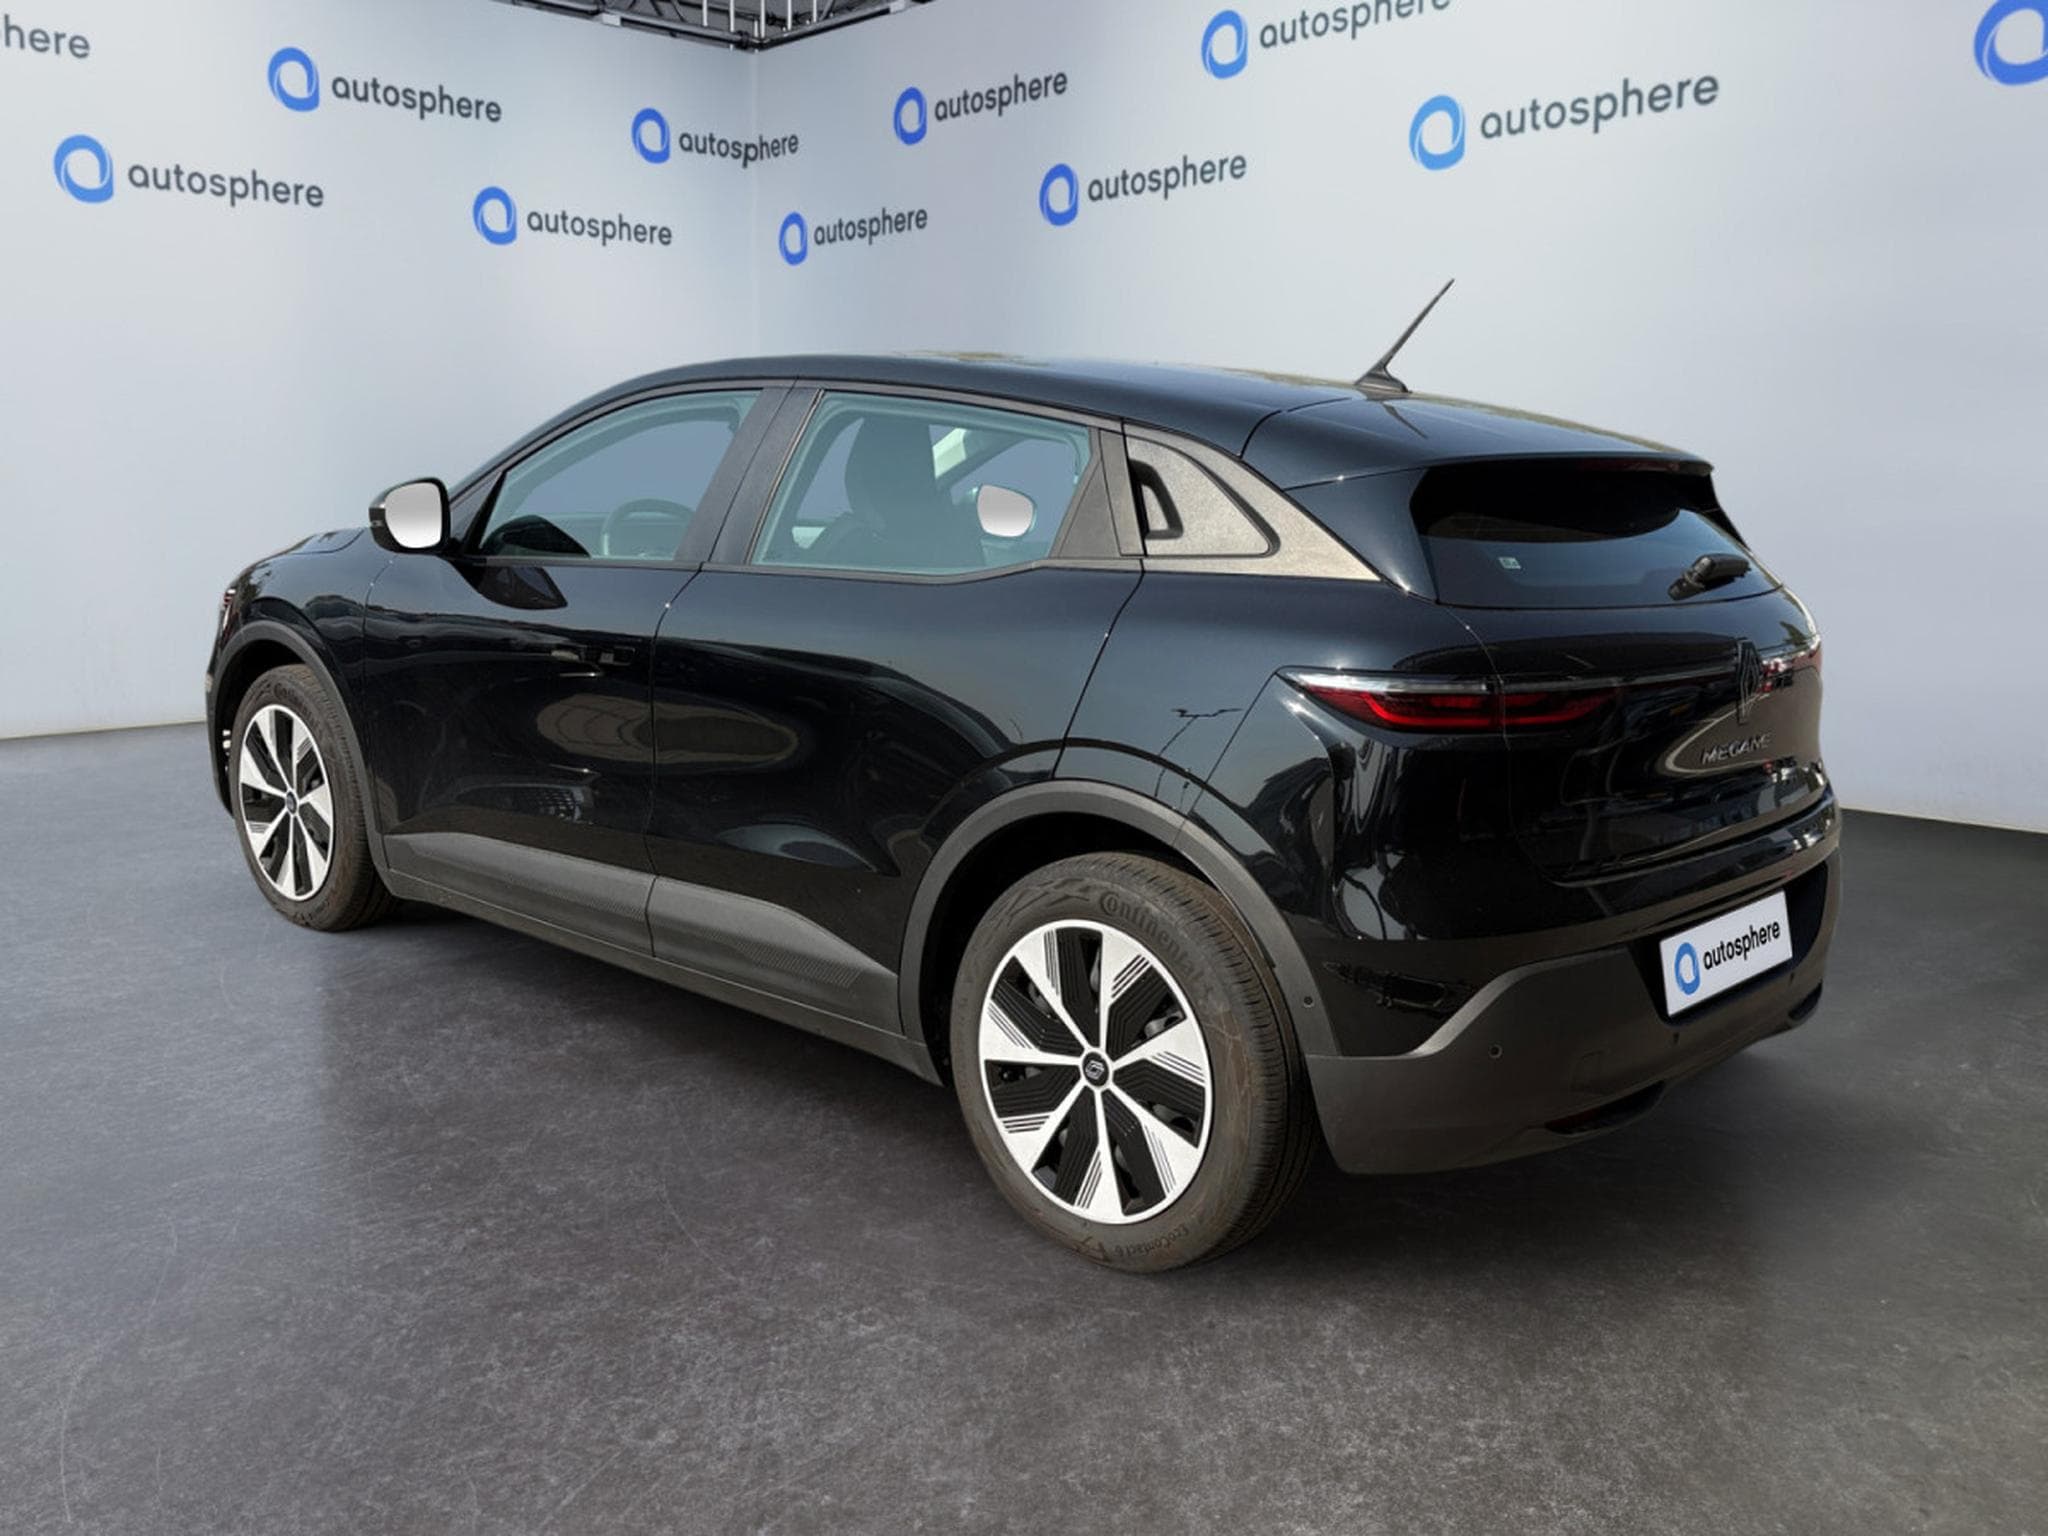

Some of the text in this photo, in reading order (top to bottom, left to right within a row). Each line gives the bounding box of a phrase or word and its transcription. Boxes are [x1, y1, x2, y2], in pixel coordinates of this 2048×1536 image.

[3, 13, 91, 59] here
[332, 75, 502, 123] autosphere
[934, 71, 1068, 121] autosphere
[1480, 74, 1720, 140] autosphere
[678, 129, 799, 168] autosphere
[127, 161, 325, 207] autosphere
[1087, 153, 1247, 202] autosphere
[526, 209, 673, 247] autosphere
[813, 206, 928, 246] autosphere
[1703, 921, 1781, 970] autosphere
